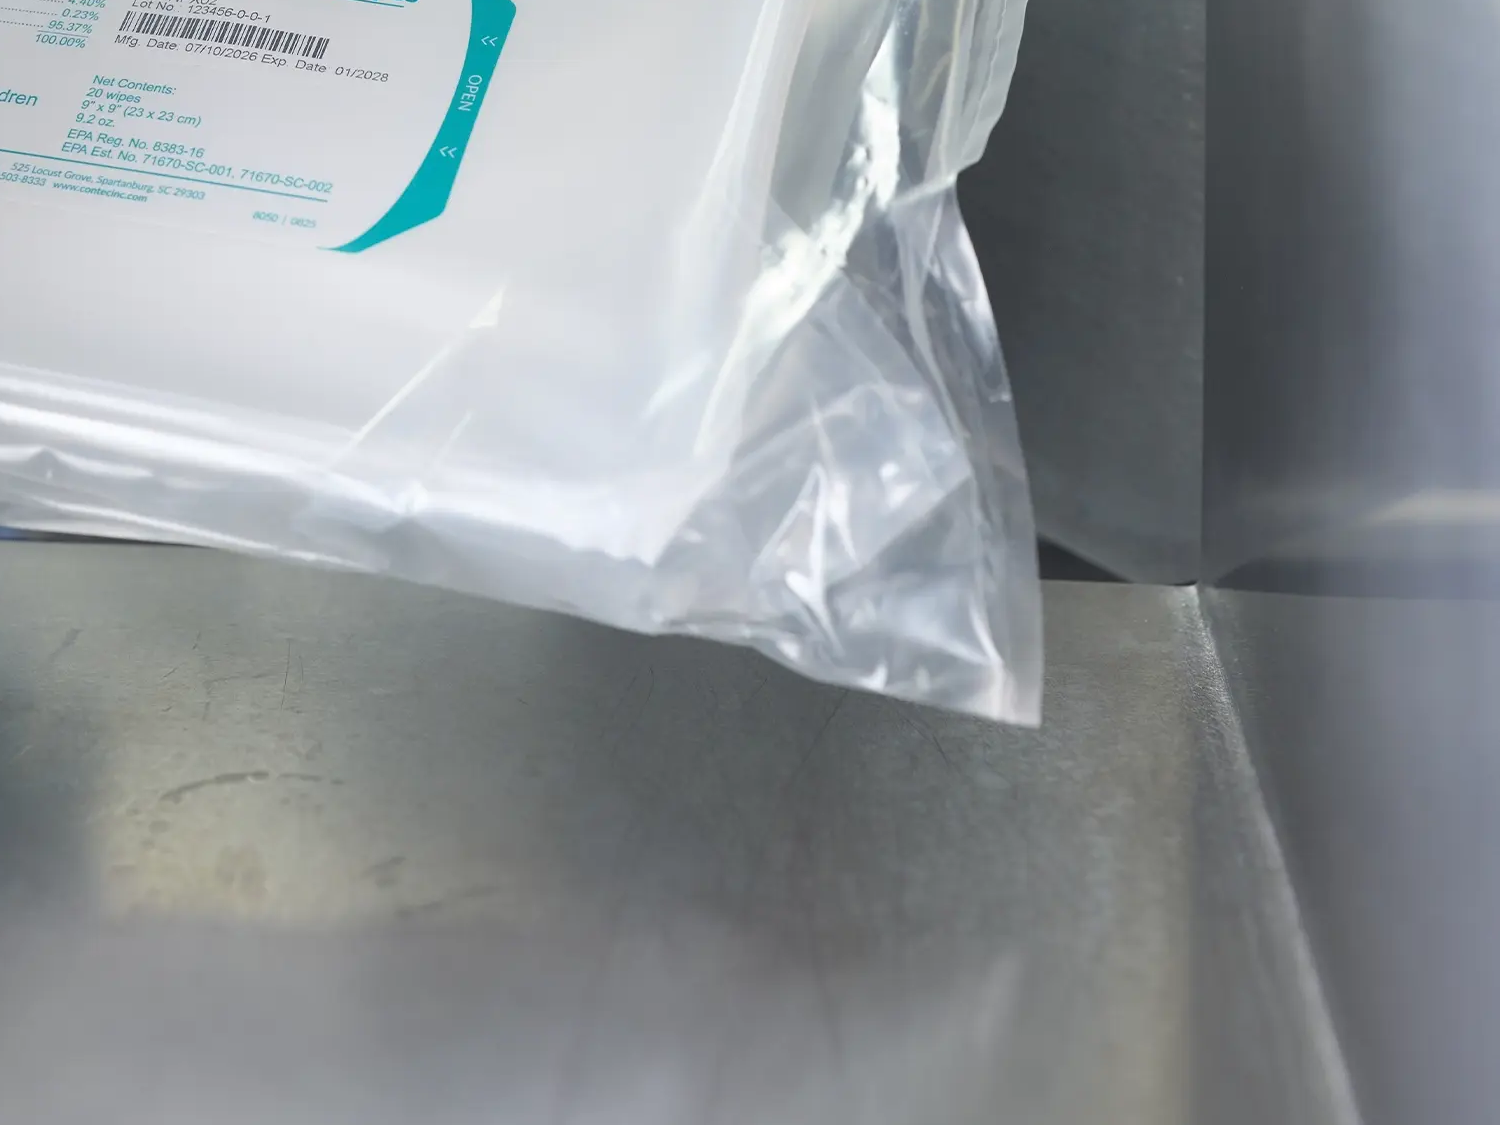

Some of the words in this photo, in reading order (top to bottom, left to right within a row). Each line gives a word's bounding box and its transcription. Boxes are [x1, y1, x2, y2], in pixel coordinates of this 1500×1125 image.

[62, 8, 100, 20] 0.23%
[188, 5, 270, 23] 123456-0-0-1
[48, 20, 93, 34] 95.37%
[36, 34, 85, 49] 100.00%
[115, 35, 141, 47] Mfg.
[185, 42, 258, 60] 07/10/2026
[335, 67, 388, 83] 01/2028
[86, 87, 104, 98] 20
[106, 90, 141, 104] wipes
[93, 75, 116, 88] Net
[118, 79, 177, 95] Contents:
[458, 75, 482, 112] OPEN
[76, 112, 96, 124] 9.2
[98, 116, 115, 127] oz.
[96, 103, 105, 112] x
[123, 105, 145, 118] (23
[147, 109, 155, 118] x
[157, 111, 174, 122] 23
[177, 114, 202, 127] cm)
[67, 129, 94, 141] EPA
[96, 132, 125, 148] Reg.
[128, 138, 149, 150] No.
[153, 141, 205, 158] 8383-16
[61, 142, 87, 155] EPA
[91, 147, 114, 159] Est.
[117, 150, 139, 163] No.
[240, 169, 333, 193] 71670-SC-002
[11, 162, 30, 172] 525
[32, 166, 62, 177] Locust
[64, 171, 94, 183] Grove,
[157, 185, 172, 195] SC
[173, 187, 205, 200] 29303
[53, 181, 148, 203] www.contecinc.com
